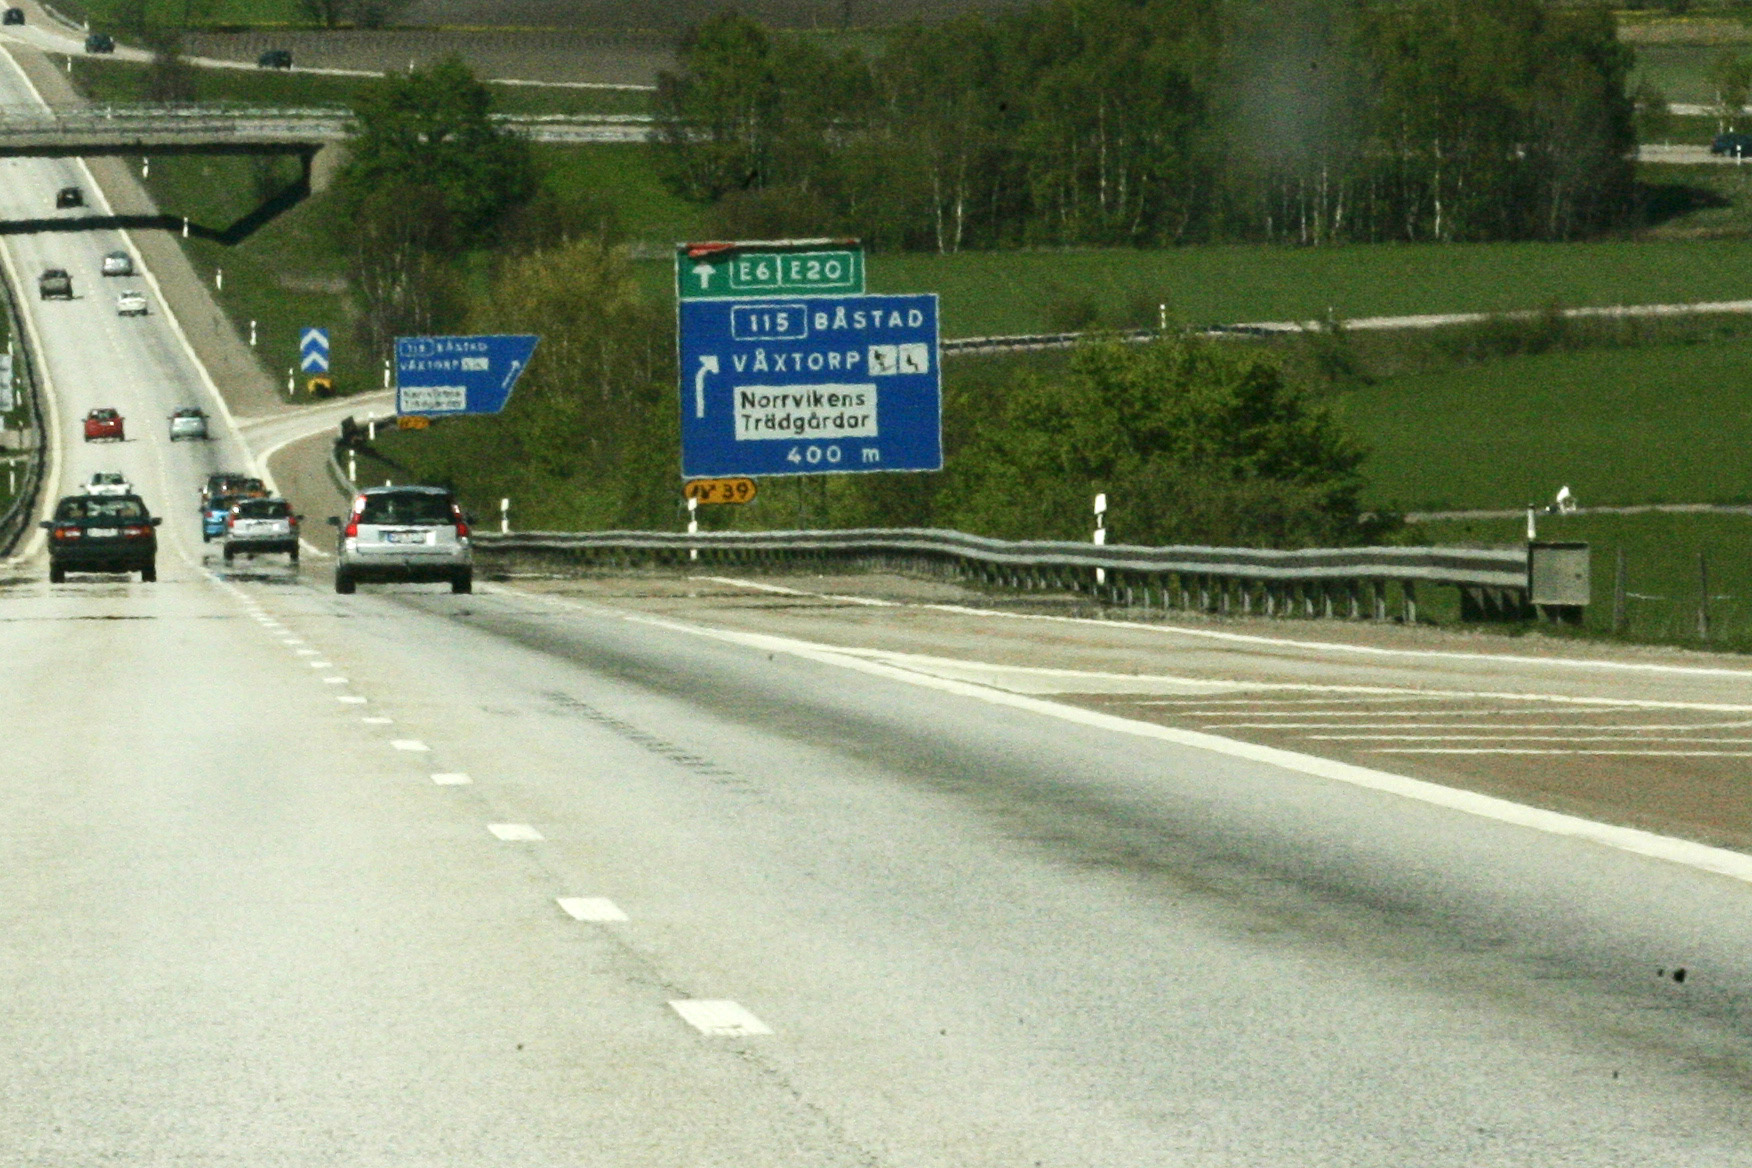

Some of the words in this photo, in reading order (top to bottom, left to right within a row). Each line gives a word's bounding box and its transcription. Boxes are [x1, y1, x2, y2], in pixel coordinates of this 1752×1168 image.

[739, 262, 770, 281] E6
[790, 261, 842, 279] E20
[749, 312, 789, 332] 115
[815, 306, 923, 330] BÅSTAD
[733, 348, 861, 372] VÅXTORP
[740, 390, 866, 409] Norrvikens
[742, 412, 870, 435] Trädgårdar
[787, 445, 842, 464] 400
[862, 447, 880, 463] m
[723, 482, 749, 499] 39
